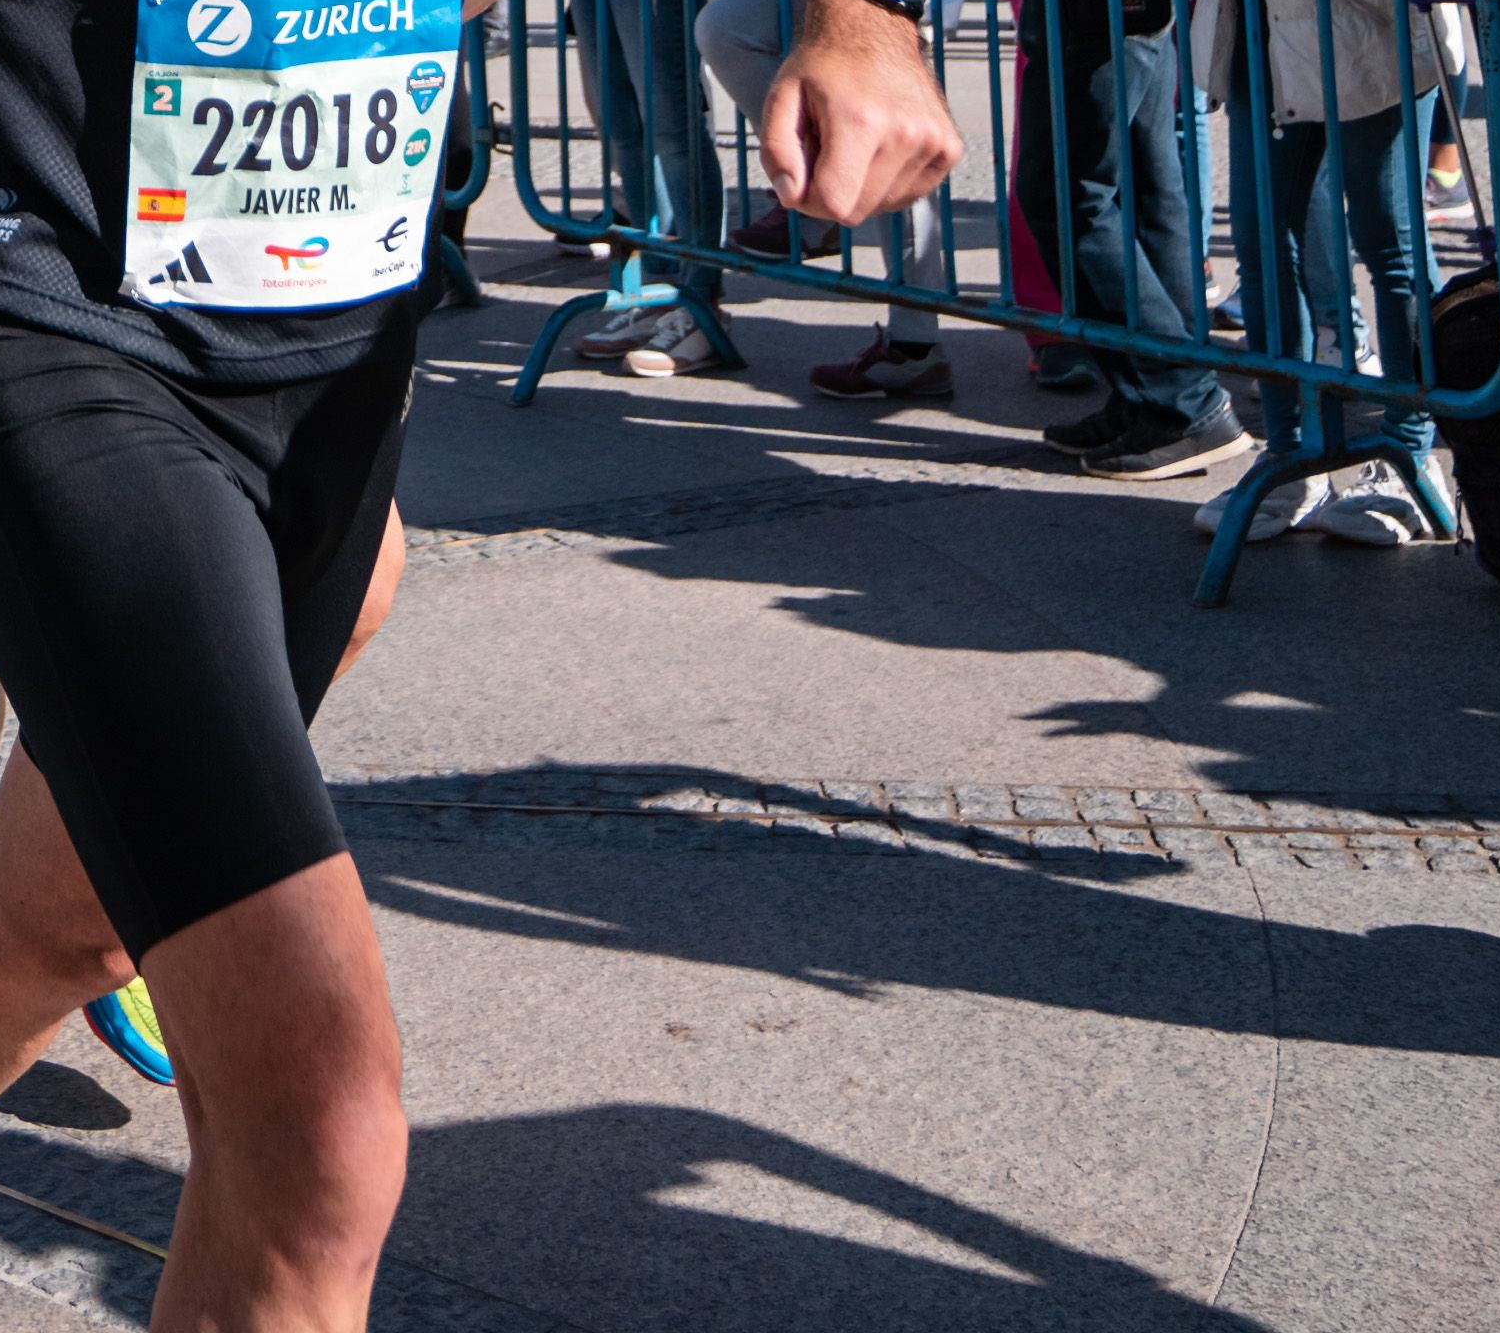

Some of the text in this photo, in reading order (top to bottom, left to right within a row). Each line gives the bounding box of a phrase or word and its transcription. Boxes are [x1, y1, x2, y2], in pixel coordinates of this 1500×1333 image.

[153, 84, 173, 111] 2
[191, 88, 399, 177] 22018
[405, 139, 428, 156] 21K
[239, 184, 357, 215] JAVIER M.
[262, 277, 328, 290] TotalEnergies
